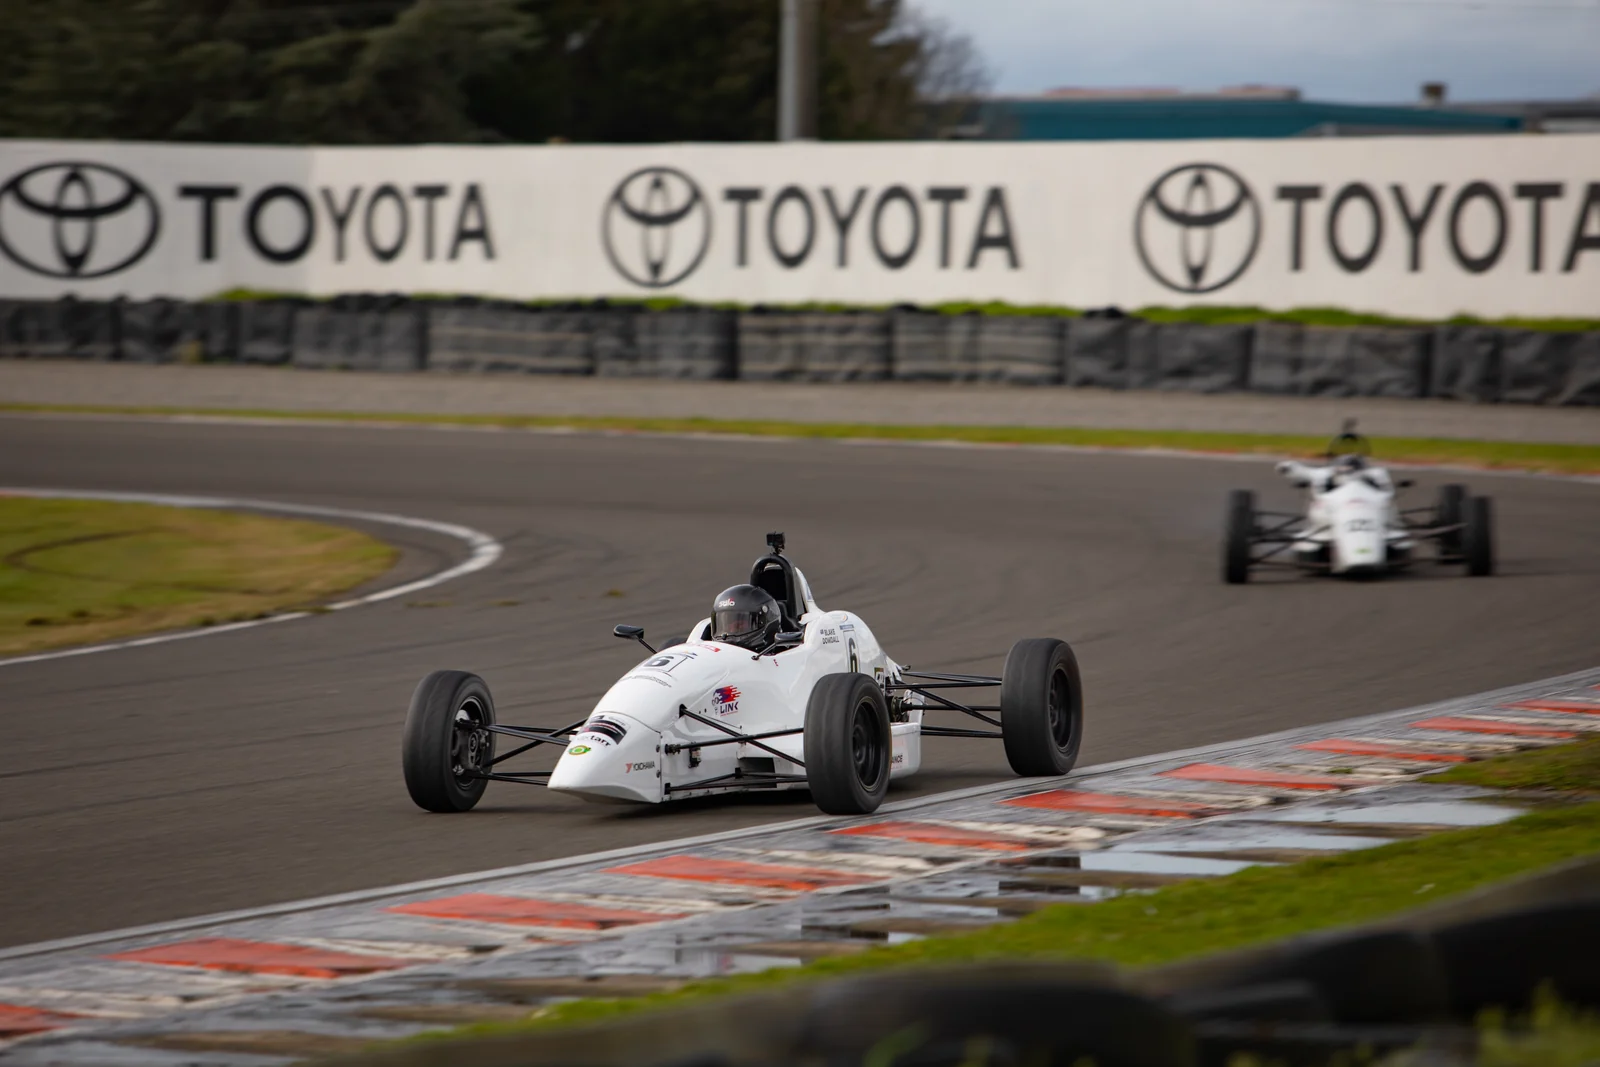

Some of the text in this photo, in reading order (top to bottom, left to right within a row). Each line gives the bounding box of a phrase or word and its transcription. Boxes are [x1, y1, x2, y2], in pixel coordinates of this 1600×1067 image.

[178, 183, 496, 264] TOYOTA
[723, 184, 1021, 270] TOYOTA
[1276, 181, 1600, 273] TOYOTA
[643, 655, 675, 668] 6
[848, 637, 858, 673] 6
[720, 701, 739, 714] LINK
